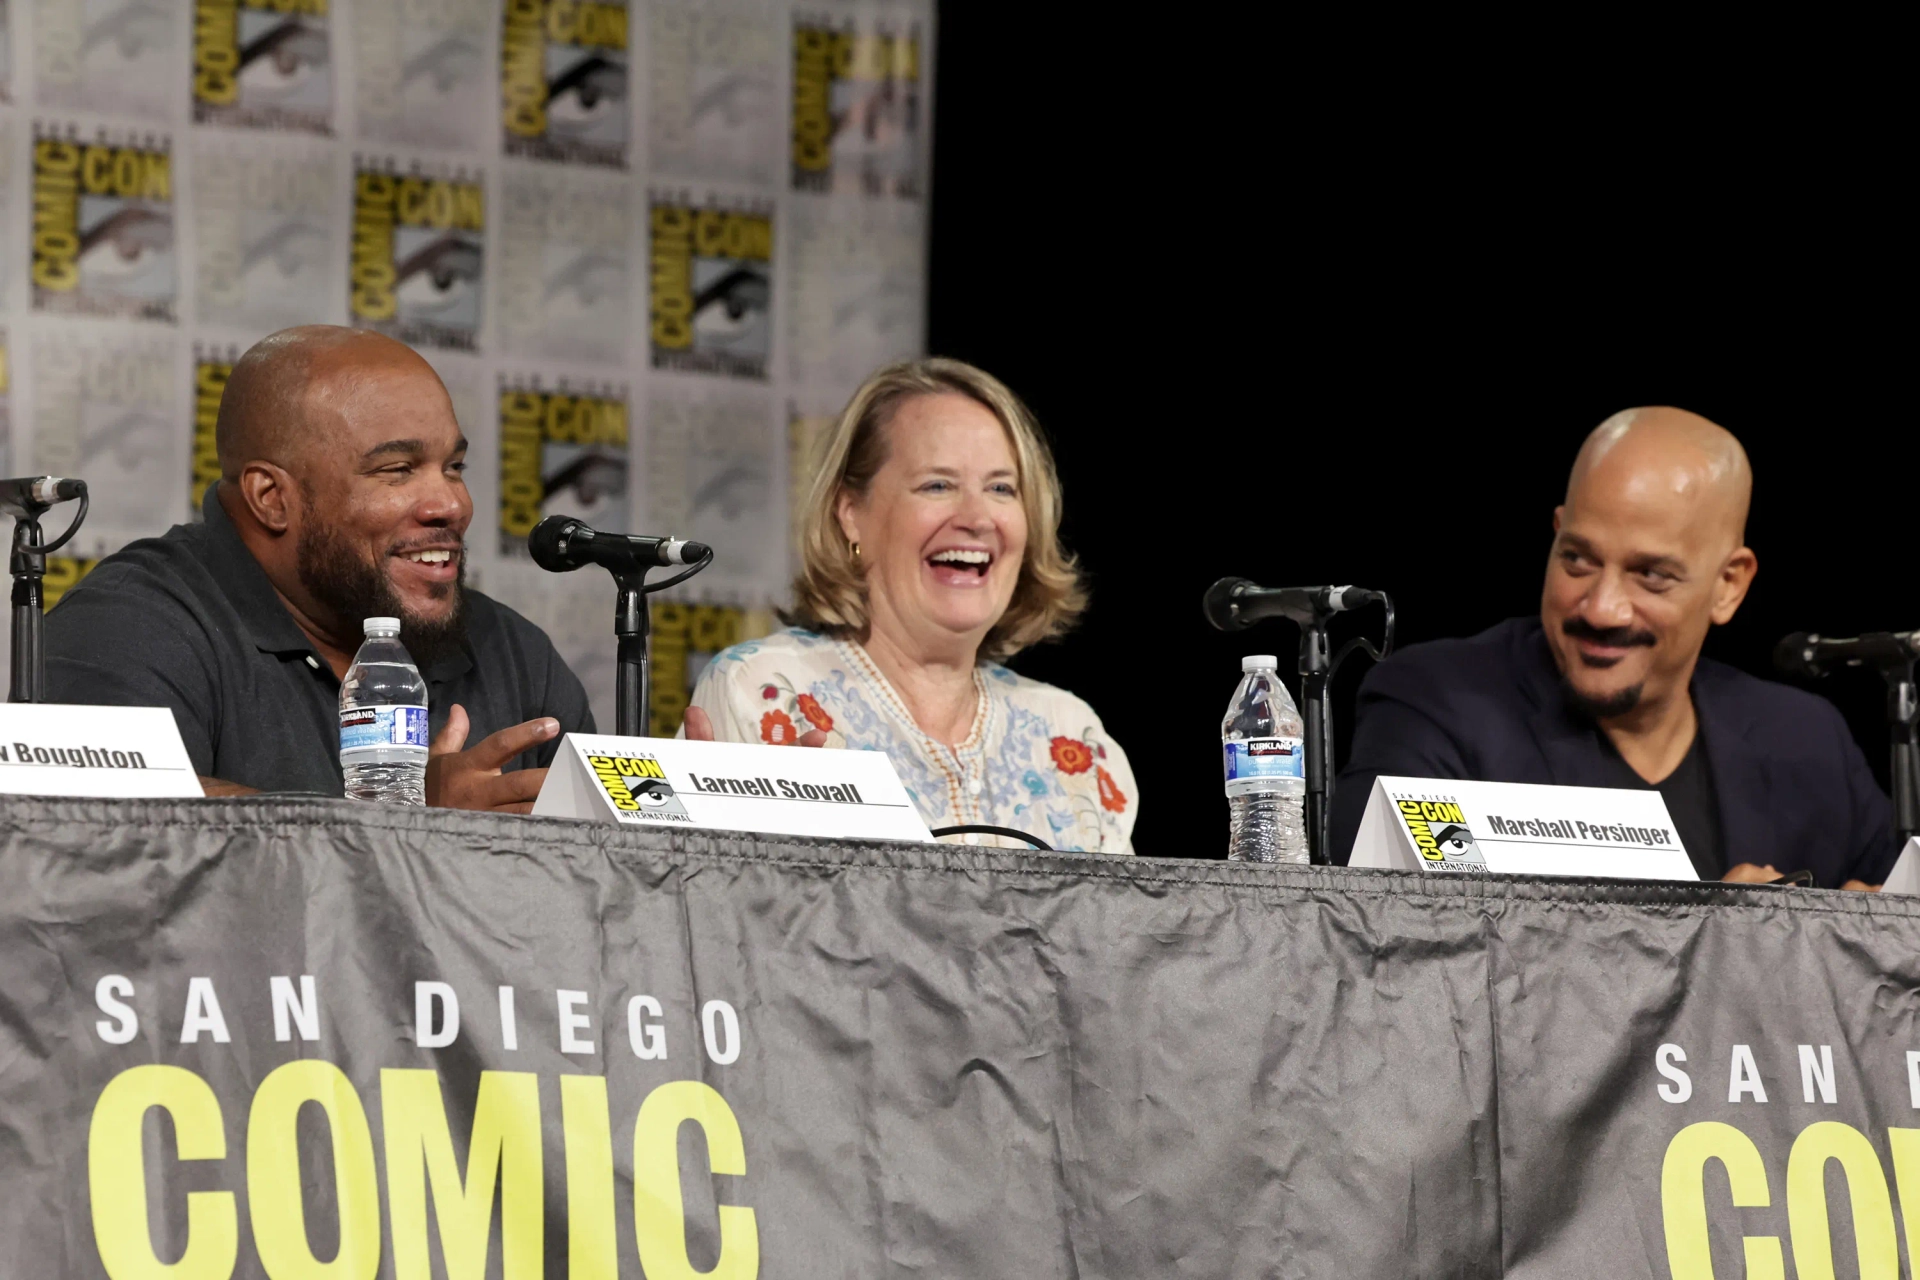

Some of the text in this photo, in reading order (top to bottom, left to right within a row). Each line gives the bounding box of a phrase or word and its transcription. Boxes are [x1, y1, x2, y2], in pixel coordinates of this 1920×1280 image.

[83, 147, 171, 201] CON
[33, 141, 79, 290] COMIC
[13, 742, 147, 768] Boughton
[614, 757, 666, 779] CON
[615, 750, 655, 759] DIEGO
[588, 756, 640, 811] COMIC
[688, 772, 864, 803] Larnell Stovall
[1392, 792, 1456, 802] SAN DIEGO
[620, 810, 694, 823] INTERNATIONAL
[1420, 801, 1467, 824] CON
[1398, 800, 1445, 861] COMIC
[1486, 814, 1672, 847] Marshall Persinger
[1425, 861, 1490, 873] INTERNATIONAL
[94, 973, 742, 1066] SAN DIEGO
[1654, 1043, 1838, 1104] SAN
[88, 1058, 760, 1280] COMIC
